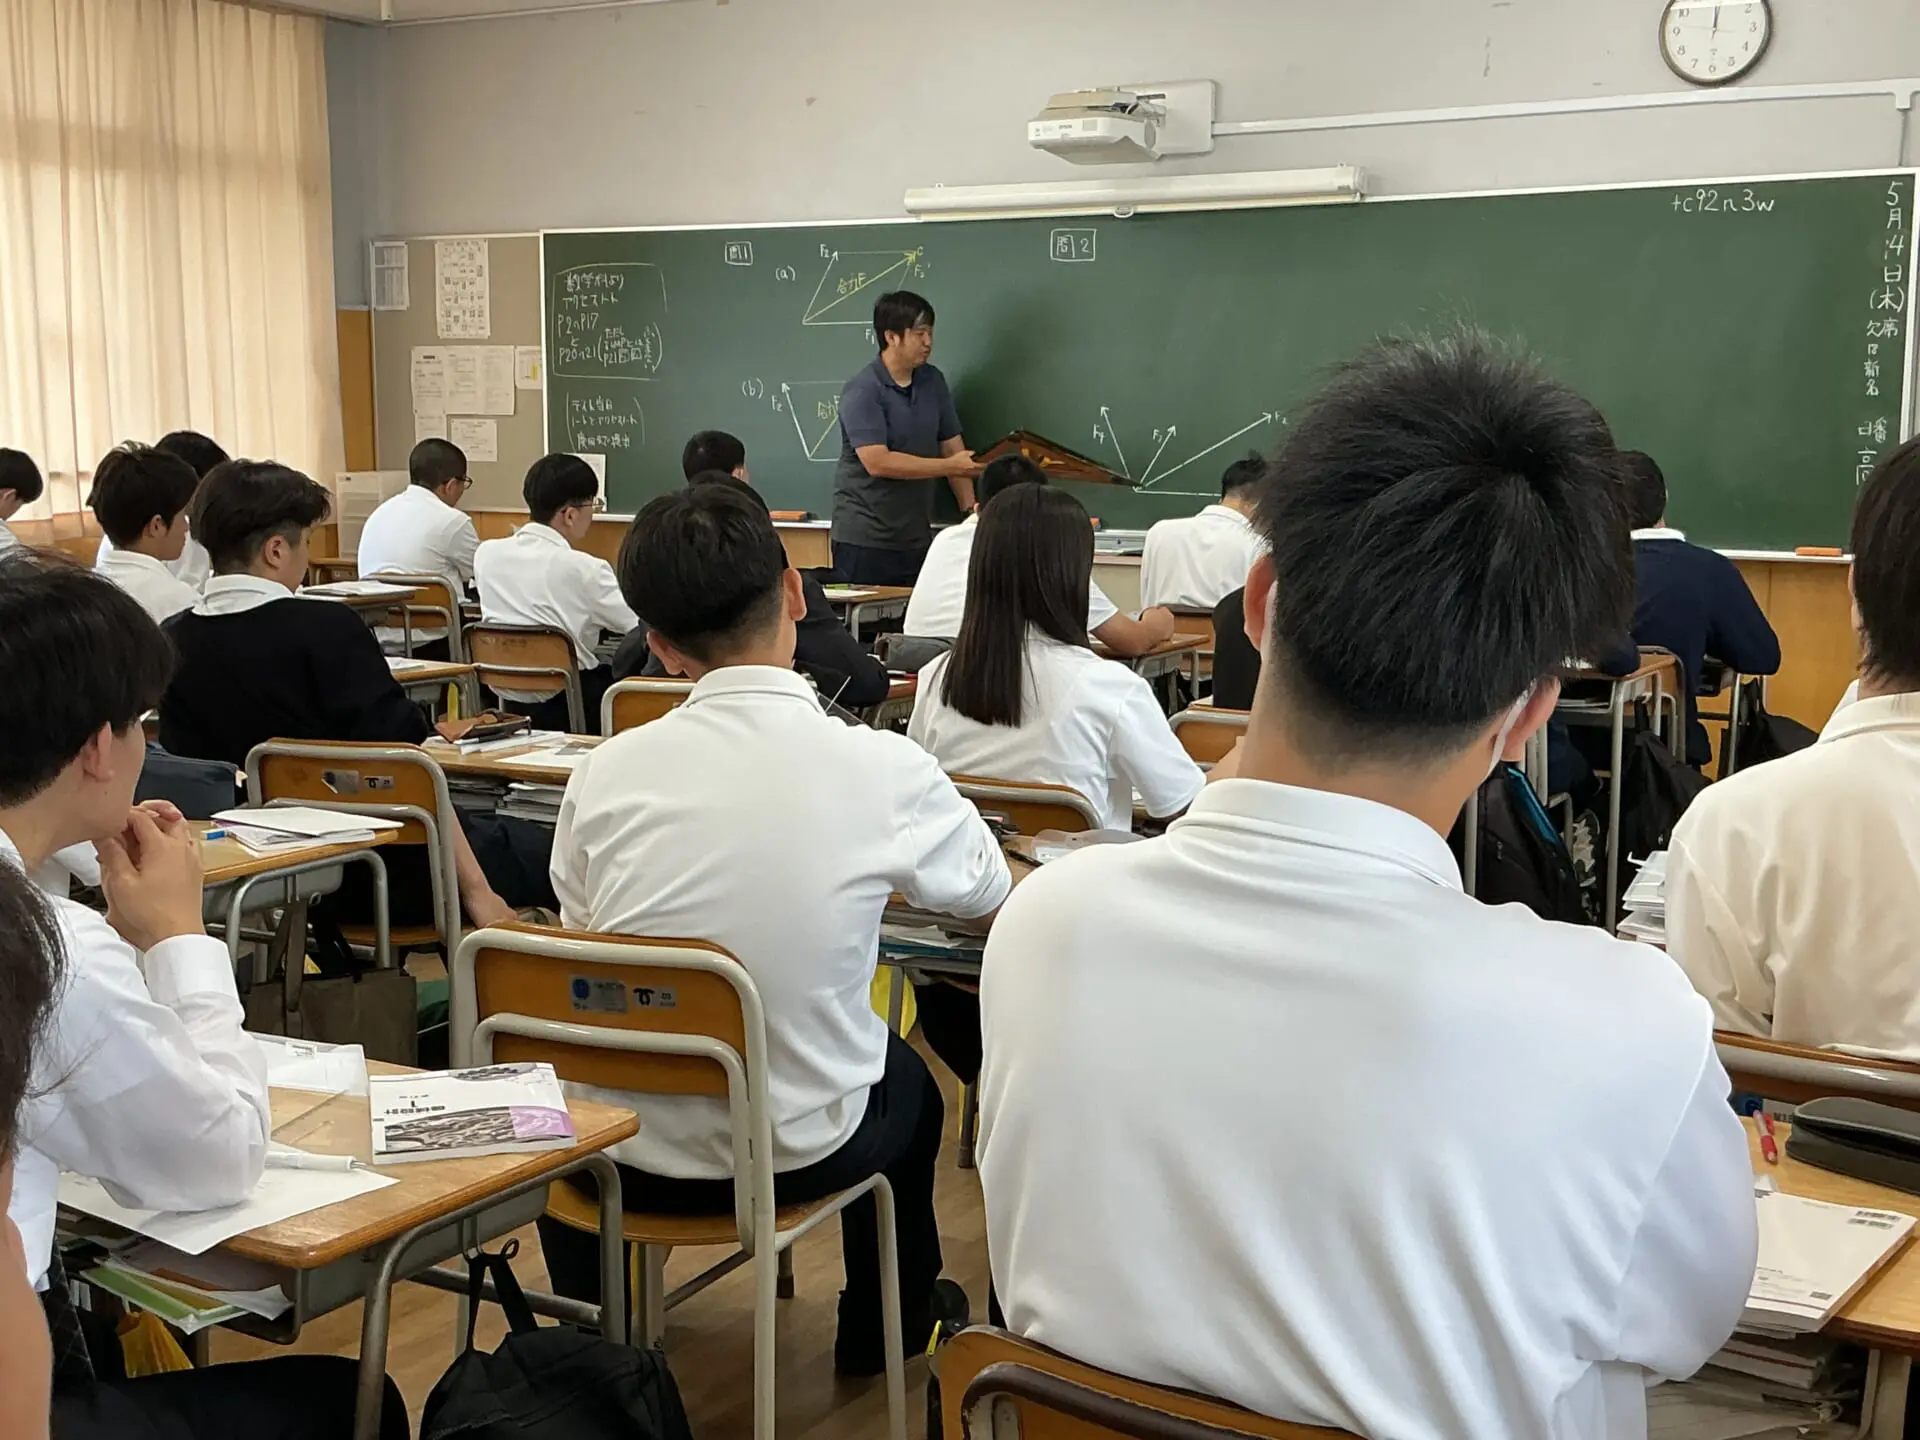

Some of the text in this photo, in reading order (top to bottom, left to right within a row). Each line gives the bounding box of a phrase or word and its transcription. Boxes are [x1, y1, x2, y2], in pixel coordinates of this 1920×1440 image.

[1673, 27, 1681, 37] 9
[1749, 22, 1757, 32] 3
[1677, 45, 1686, 55] 8
[1742, 41, 1749, 51] 4
[1691, 58, 1699, 68] 7
[1728, 56, 1735, 67] 5
[1709, 64, 1716, 74] 6
[775, 264, 796, 282] (a)
[742, 378, 764, 399] (b)
